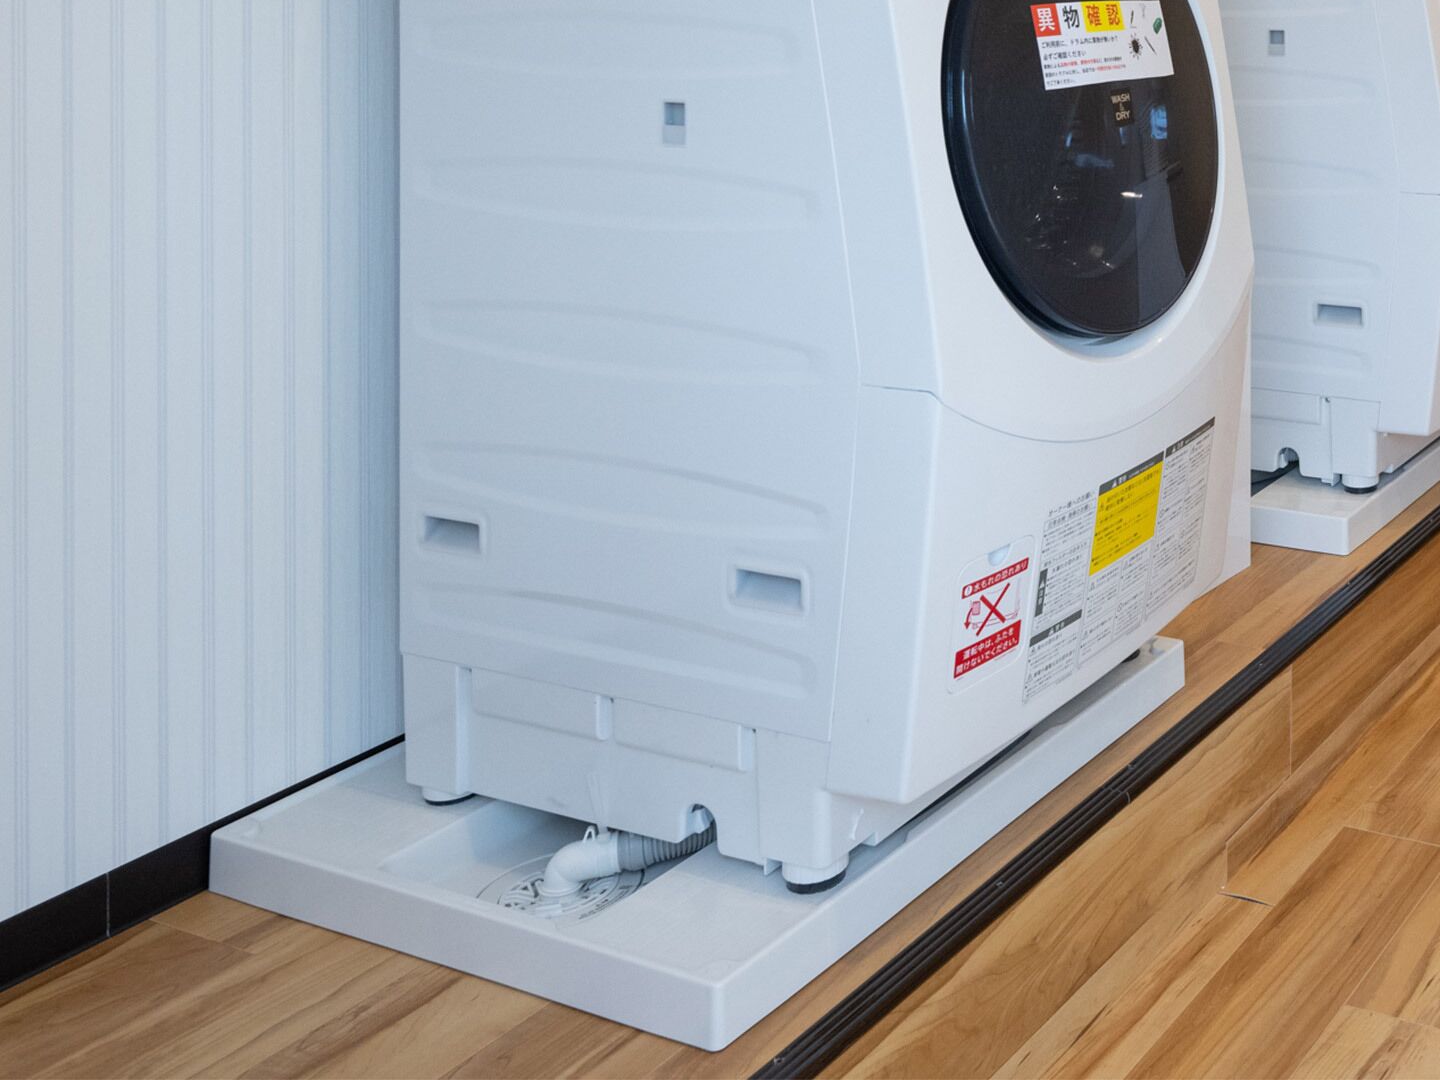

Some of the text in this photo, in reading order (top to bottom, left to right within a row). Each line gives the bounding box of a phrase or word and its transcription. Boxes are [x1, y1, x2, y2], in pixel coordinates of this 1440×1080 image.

[1037, 4, 1121, 32] 異物確認
[1110, 92, 1130, 103] WASH
[1115, 111, 1130, 121] DRY
[973, 560, 1027, 593] 水もれの恐れあり
